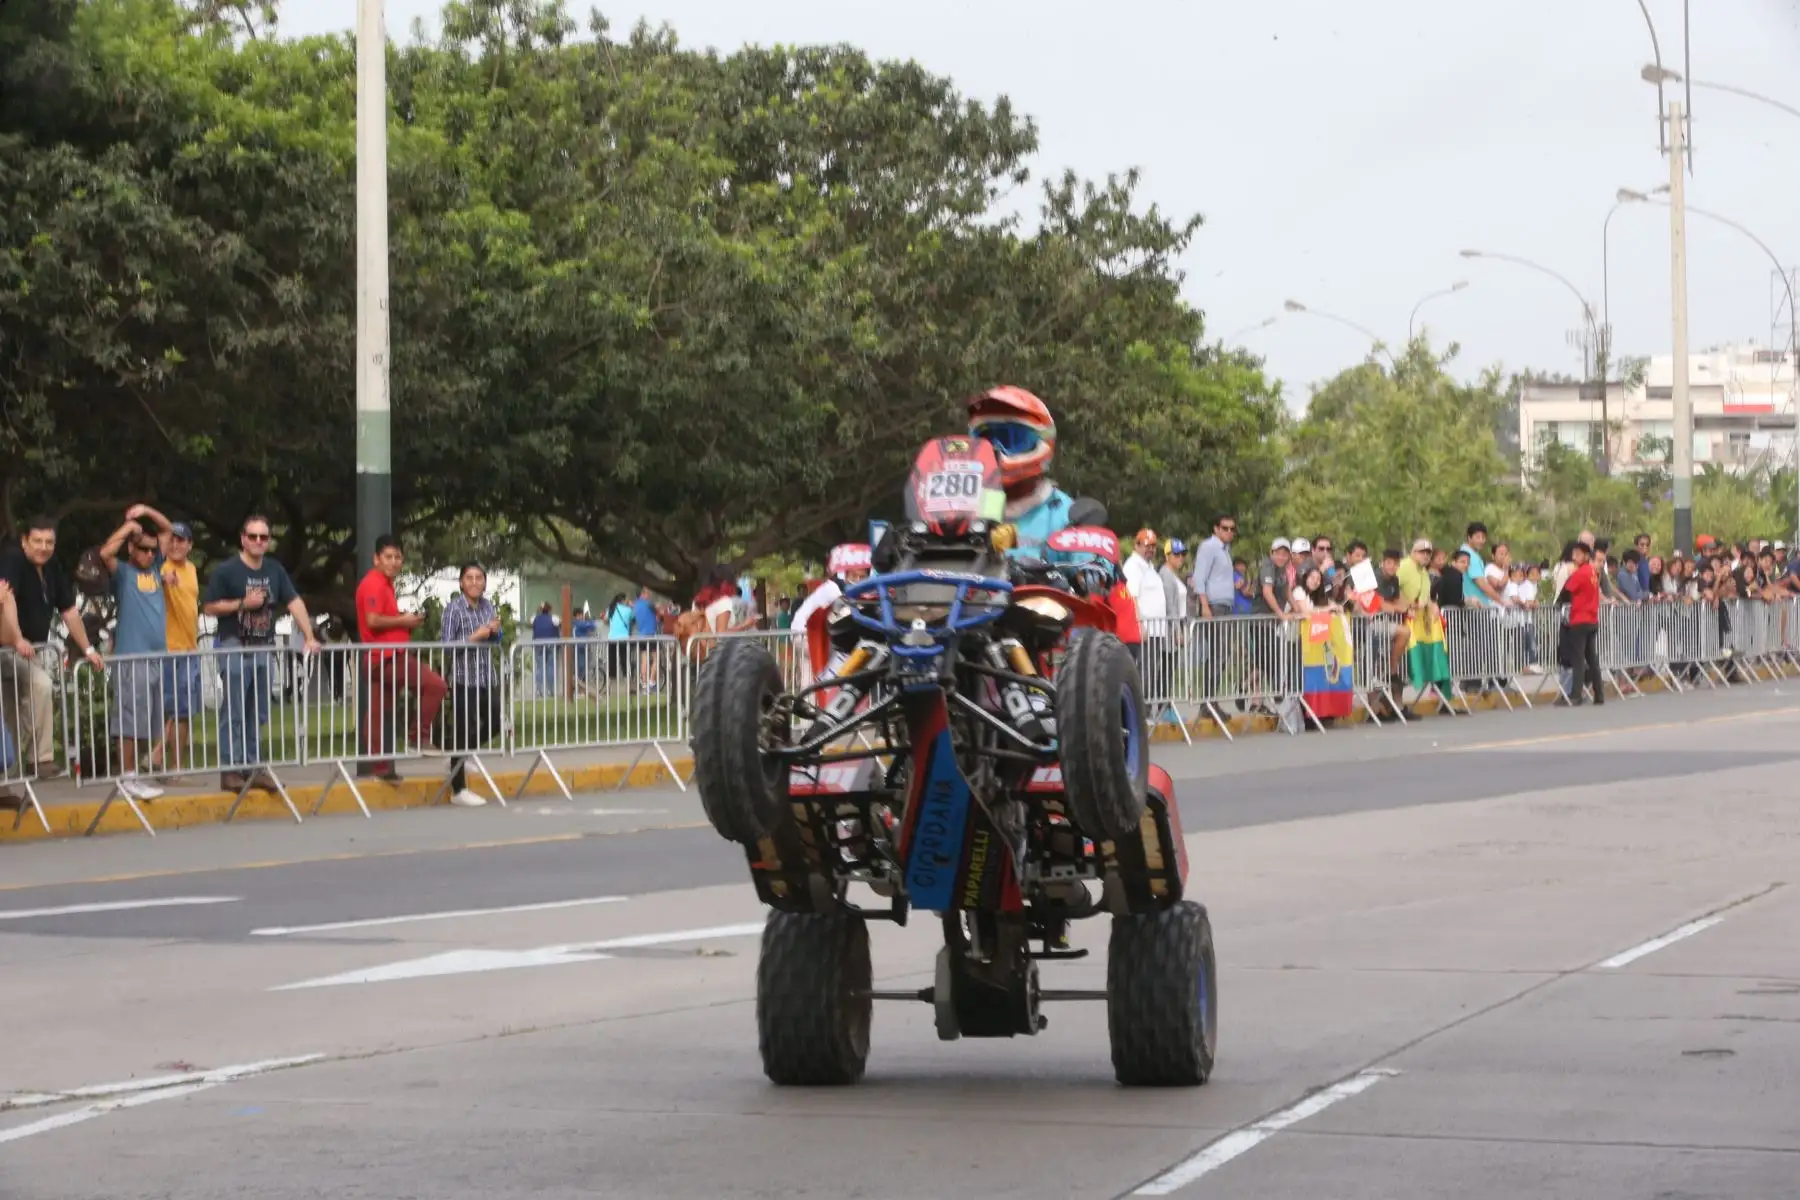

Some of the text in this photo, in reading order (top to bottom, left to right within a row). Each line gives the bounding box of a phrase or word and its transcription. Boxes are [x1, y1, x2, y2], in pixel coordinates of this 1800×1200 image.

[930, 474, 979, 498] 280
[912, 779, 954, 888] GIORDANA
[963, 829, 990, 907] PAPARELLI
